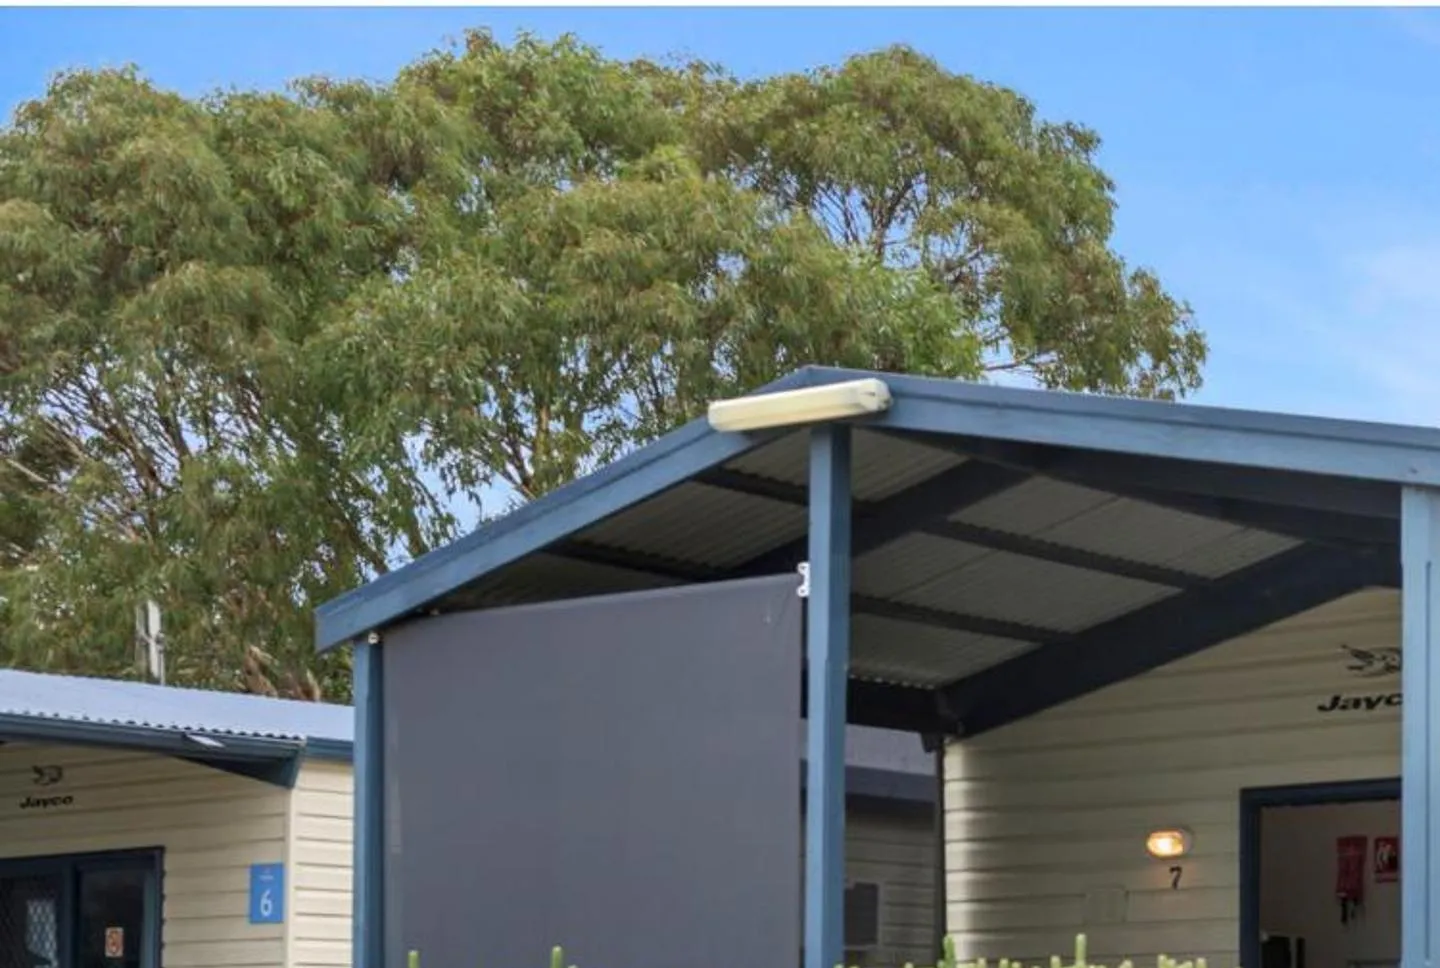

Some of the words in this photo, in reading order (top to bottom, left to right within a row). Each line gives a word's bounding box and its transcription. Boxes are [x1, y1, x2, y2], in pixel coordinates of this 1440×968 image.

[1317, 693, 1403, 712] Jayc
[1169, 866, 1182, 890] 7
[260, 888, 273, 917] 6
